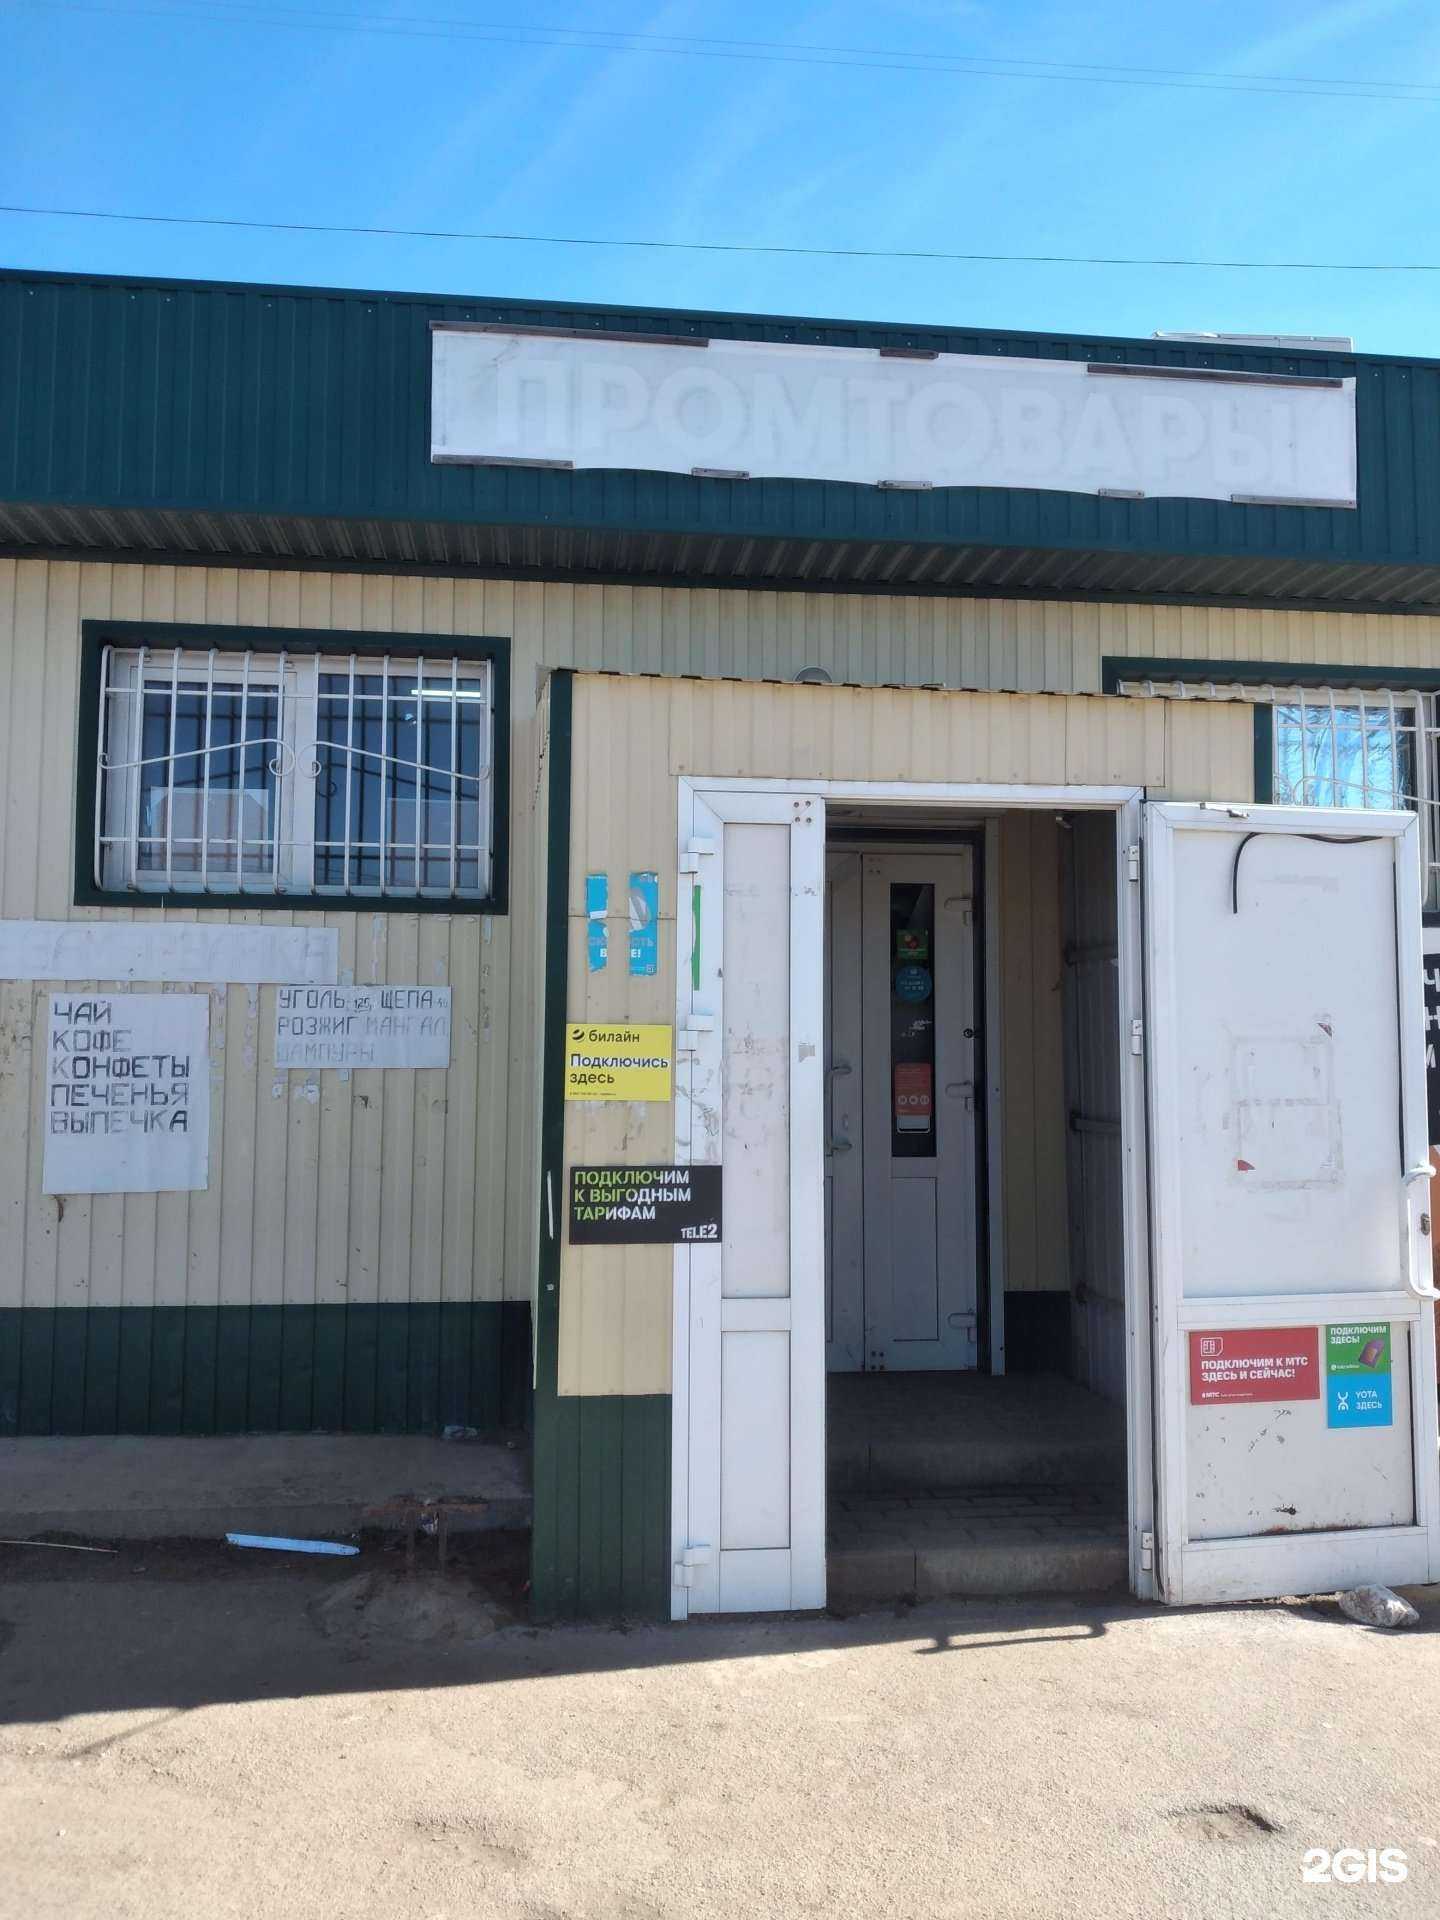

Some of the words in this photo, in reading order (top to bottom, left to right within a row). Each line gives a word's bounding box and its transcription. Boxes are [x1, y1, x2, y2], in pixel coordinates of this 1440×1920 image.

[496, 358, 1294, 485] ПРОМТОВАРЫ
[279, 990, 345, 1009] УГОЛЬ
[381, 990, 433, 1010] ЩЕПА
[54, 1000, 112, 1025] ЧАЙ
[278, 1016, 360, 1036] РОЗЖИГ
[52, 1029, 132, 1052] КОФЕ
[589, 1029, 640, 1042] билайн
[52, 1055, 190, 1079] КОНФЕТЫ
[570, 1053, 669, 1069] Подключись
[570, 1073, 615, 1085] здесь
[51, 1083, 189, 1107] ПЕЧЕНЬЯ
[50, 1110, 188, 1134] ВЫПЕЧКА
[574, 1170, 690, 1187] ПОДКЛЮЧИМ
[574, 1188, 585, 1203] К
[590, 1187, 692, 1205] ВЫГОДНЫМ
[574, 1205, 656, 1220] ТАРИФАМ
[680, 1223, 718, 1239] TELE2
[1331, 1326, 1387, 1335] ПОДКЛЮЧИМ
[1330, 1336, 1360, 1345] ЗДЕСЬ!
[1201, 1358, 1274, 1370] ПОДКЛЮЧИМ
[1276, 1358, 1283, 1366] К
[1286, 1356, 1308, 1366] МТС
[1201, 1371, 1238, 1382] ЗДЕСЬ
[1240, 1371, 1247, 1379] И
[1249, 1368, 1296, 1379] СЕЙЧАС!
[1355, 1390, 1378, 1399] YOTA
[1356, 1401, 1383, 1410] ЗДЕСЬ
